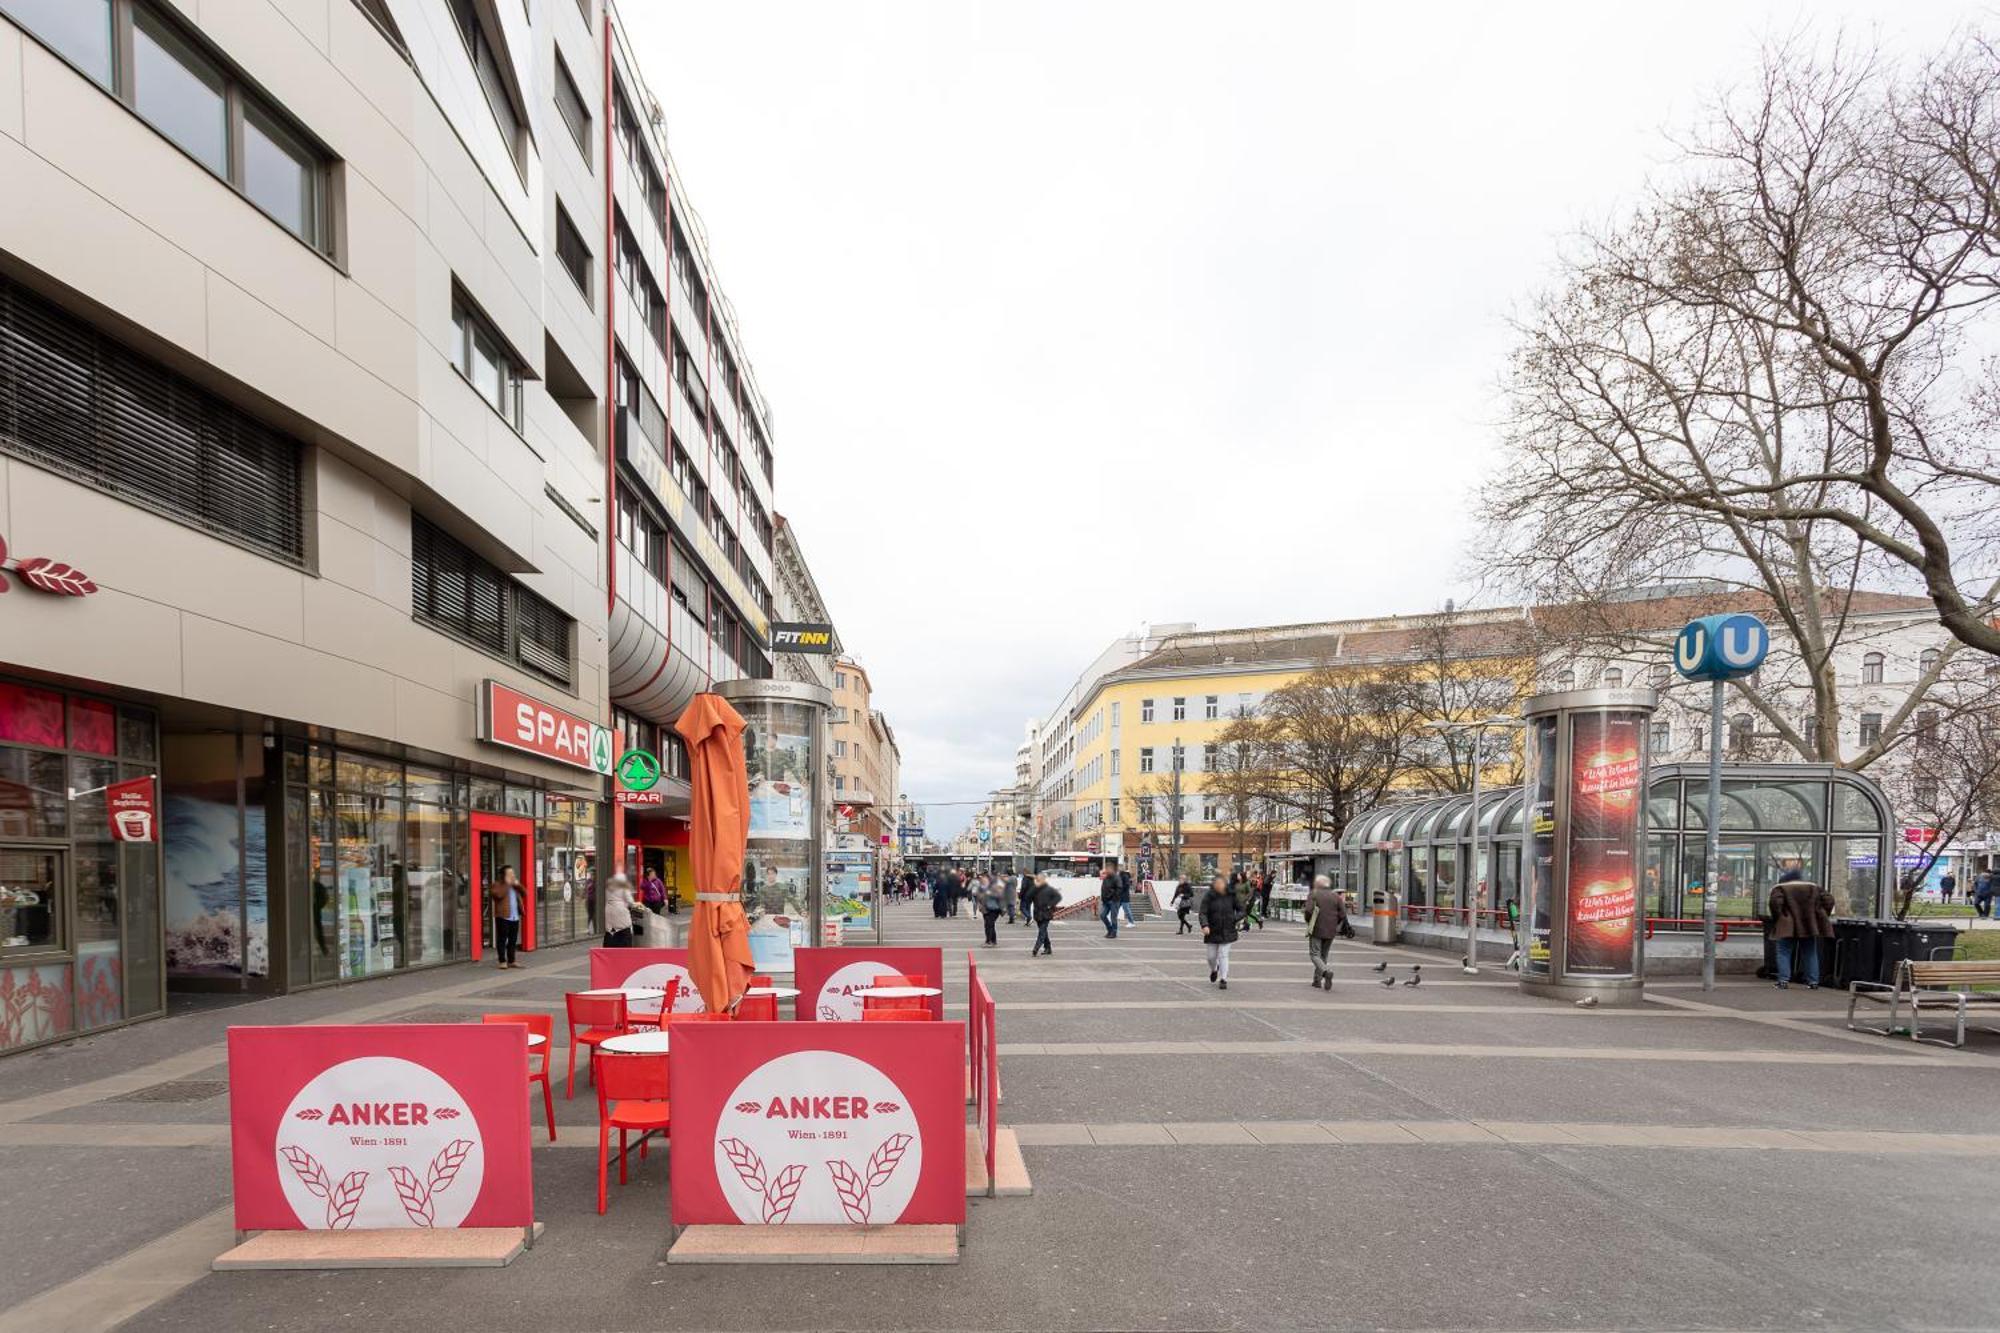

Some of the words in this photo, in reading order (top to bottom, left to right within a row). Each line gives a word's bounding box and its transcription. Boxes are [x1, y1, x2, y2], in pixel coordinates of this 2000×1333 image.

[775, 631, 829, 645] FITINN
[1723, 626, 1760, 665] U
[1679, 629, 1705, 671] U
[516, 702, 590, 760] SPAR
[616, 792, 660, 803] SPAR
[327, 1103, 429, 1126] ANKER
[765, 1096, 869, 1119] ANKER
[350, 1136, 377, 1146] Wien
[383, 1137, 408, 1146] 1891
[787, 1129, 816, 1140] Wien
[823, 1130, 848, 1140] 1891
